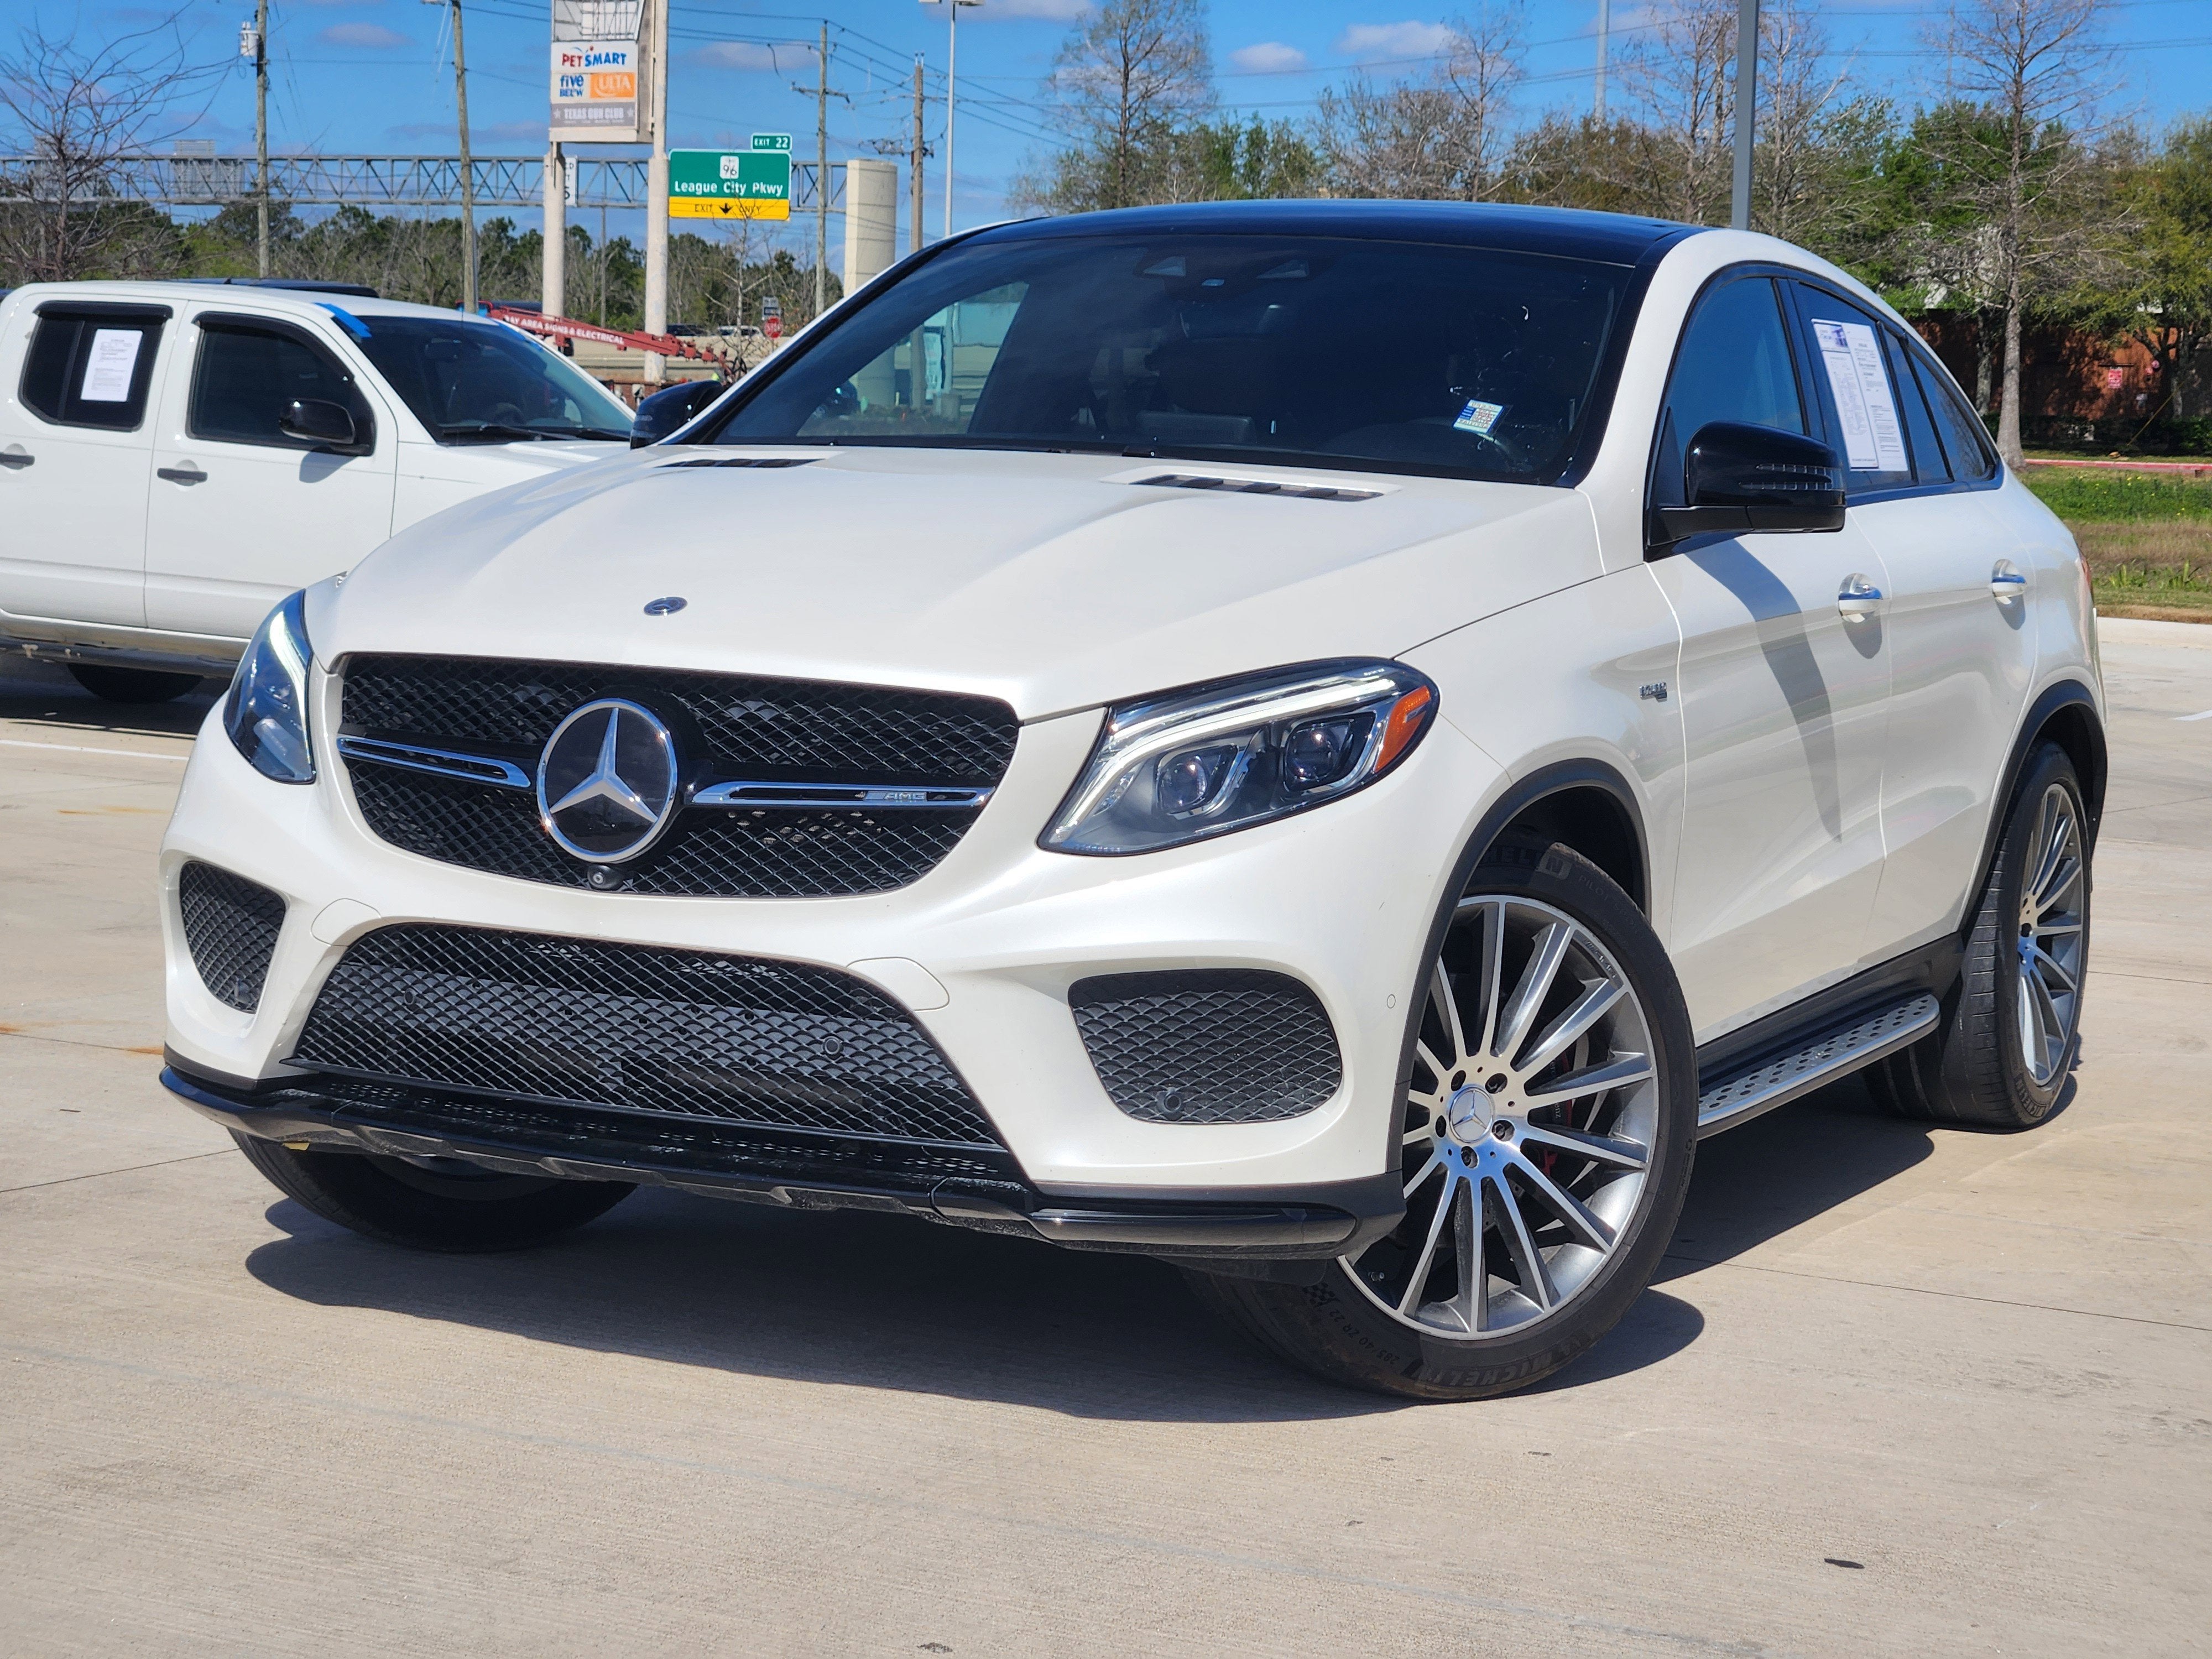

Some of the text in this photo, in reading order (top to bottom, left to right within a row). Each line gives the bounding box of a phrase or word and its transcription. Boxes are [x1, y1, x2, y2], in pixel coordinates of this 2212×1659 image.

[562, 52, 627, 67] PETSMART
[560, 74, 584, 87] five
[599, 75, 631, 90] ULTA
[775, 138, 788, 148] 22
[723, 164, 738, 176] 96
[675, 181, 783, 197] League City Pkwy
[695, 204, 712, 213] EXIT
[520, 319, 543, 330] AREA
[576, 328, 625, 345] ELECTRICAL
